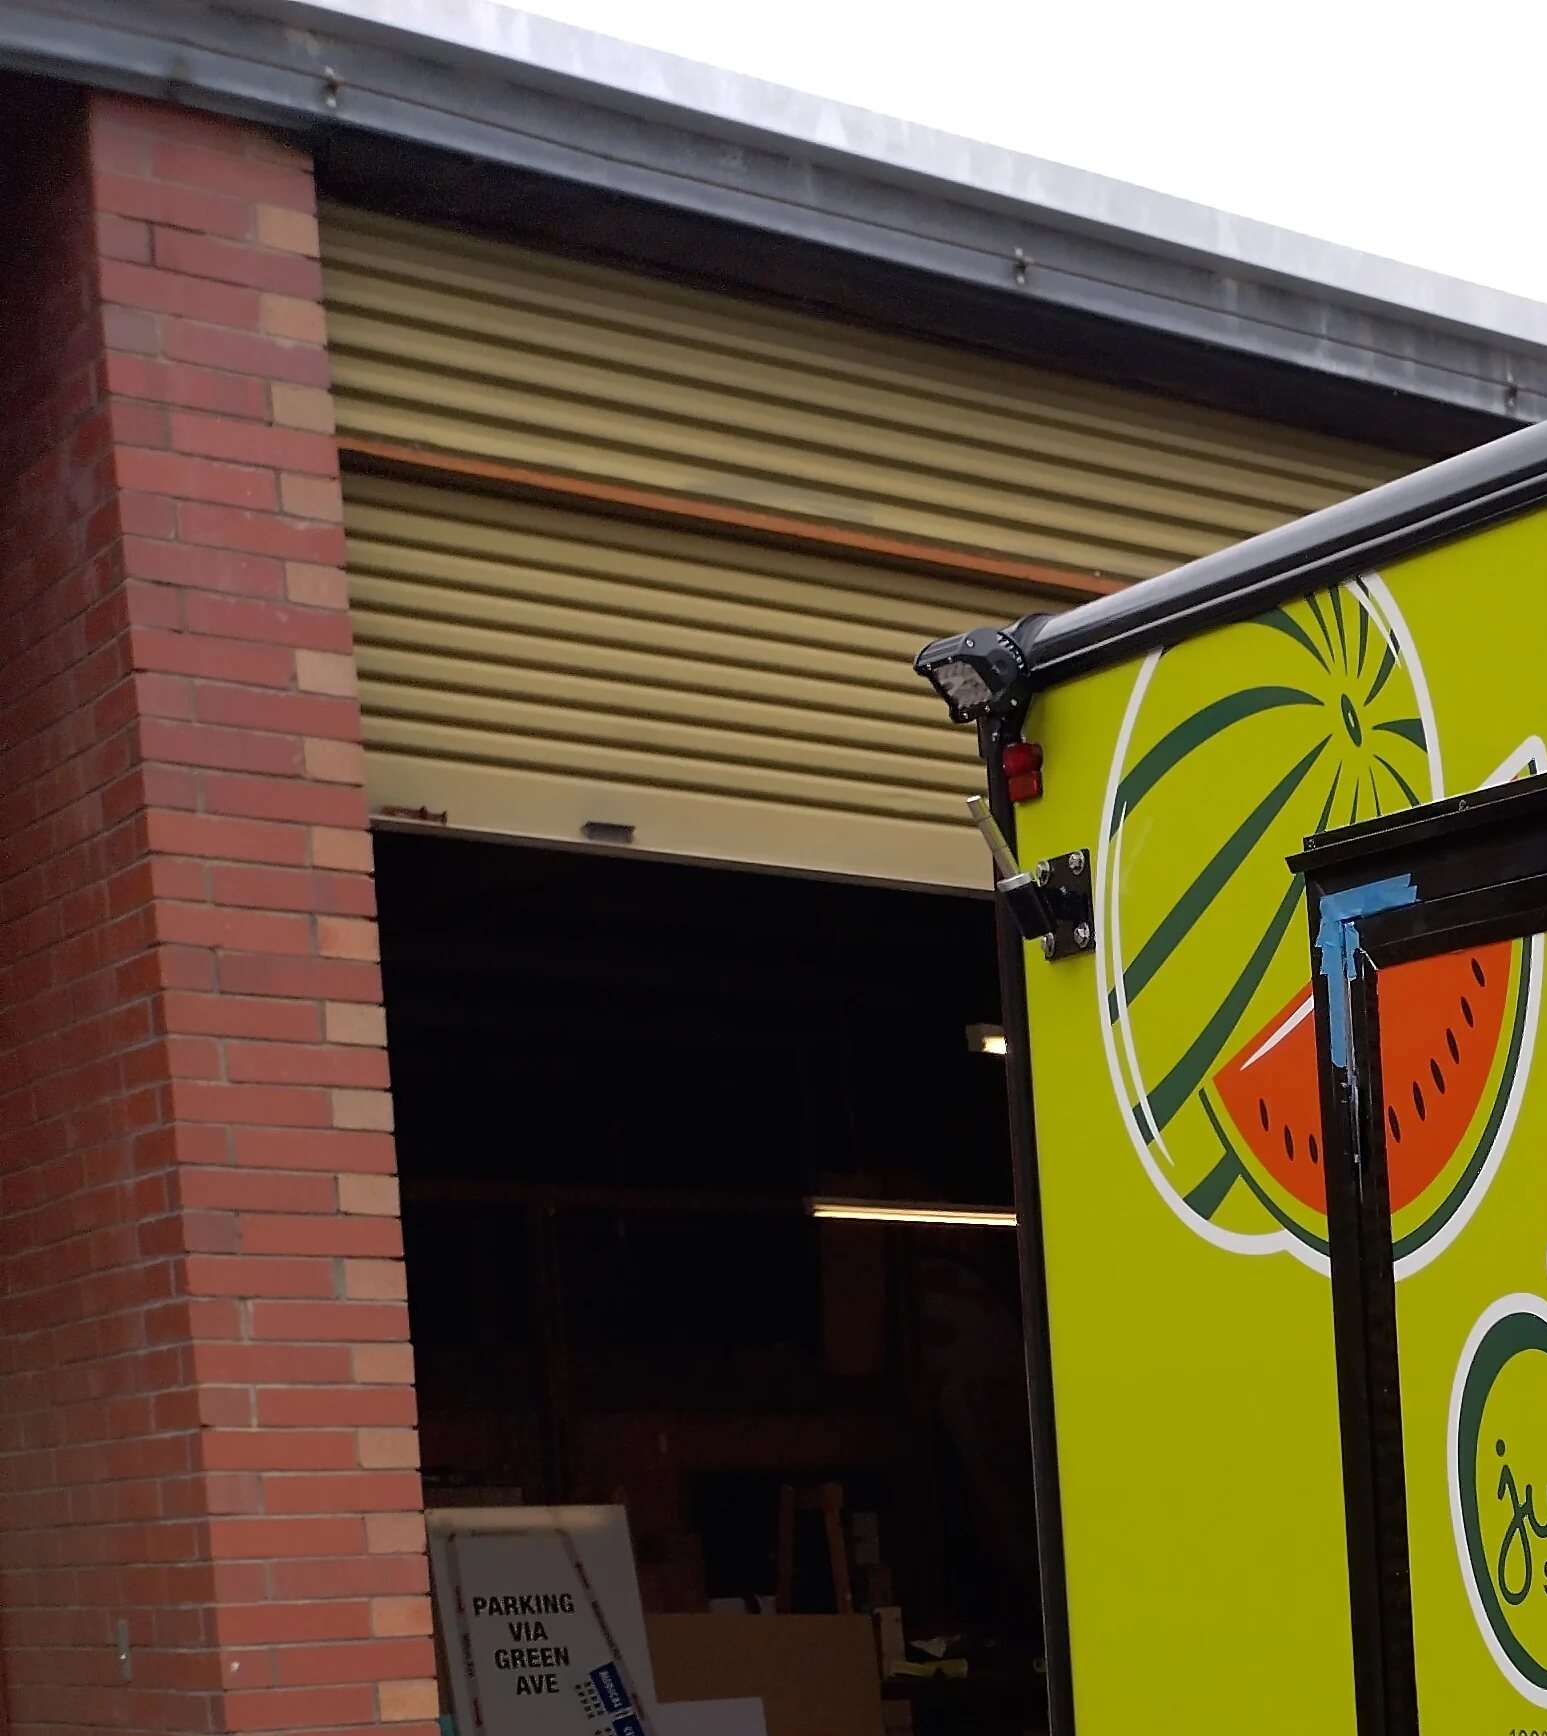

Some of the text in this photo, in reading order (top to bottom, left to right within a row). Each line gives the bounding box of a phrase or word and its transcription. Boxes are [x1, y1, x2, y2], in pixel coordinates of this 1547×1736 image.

[472, 1593, 576, 1617] PARKING
[507, 1620, 549, 1642] VIA
[493, 1646, 570, 1671] GREEN
[515, 1673, 561, 1696] AVE
